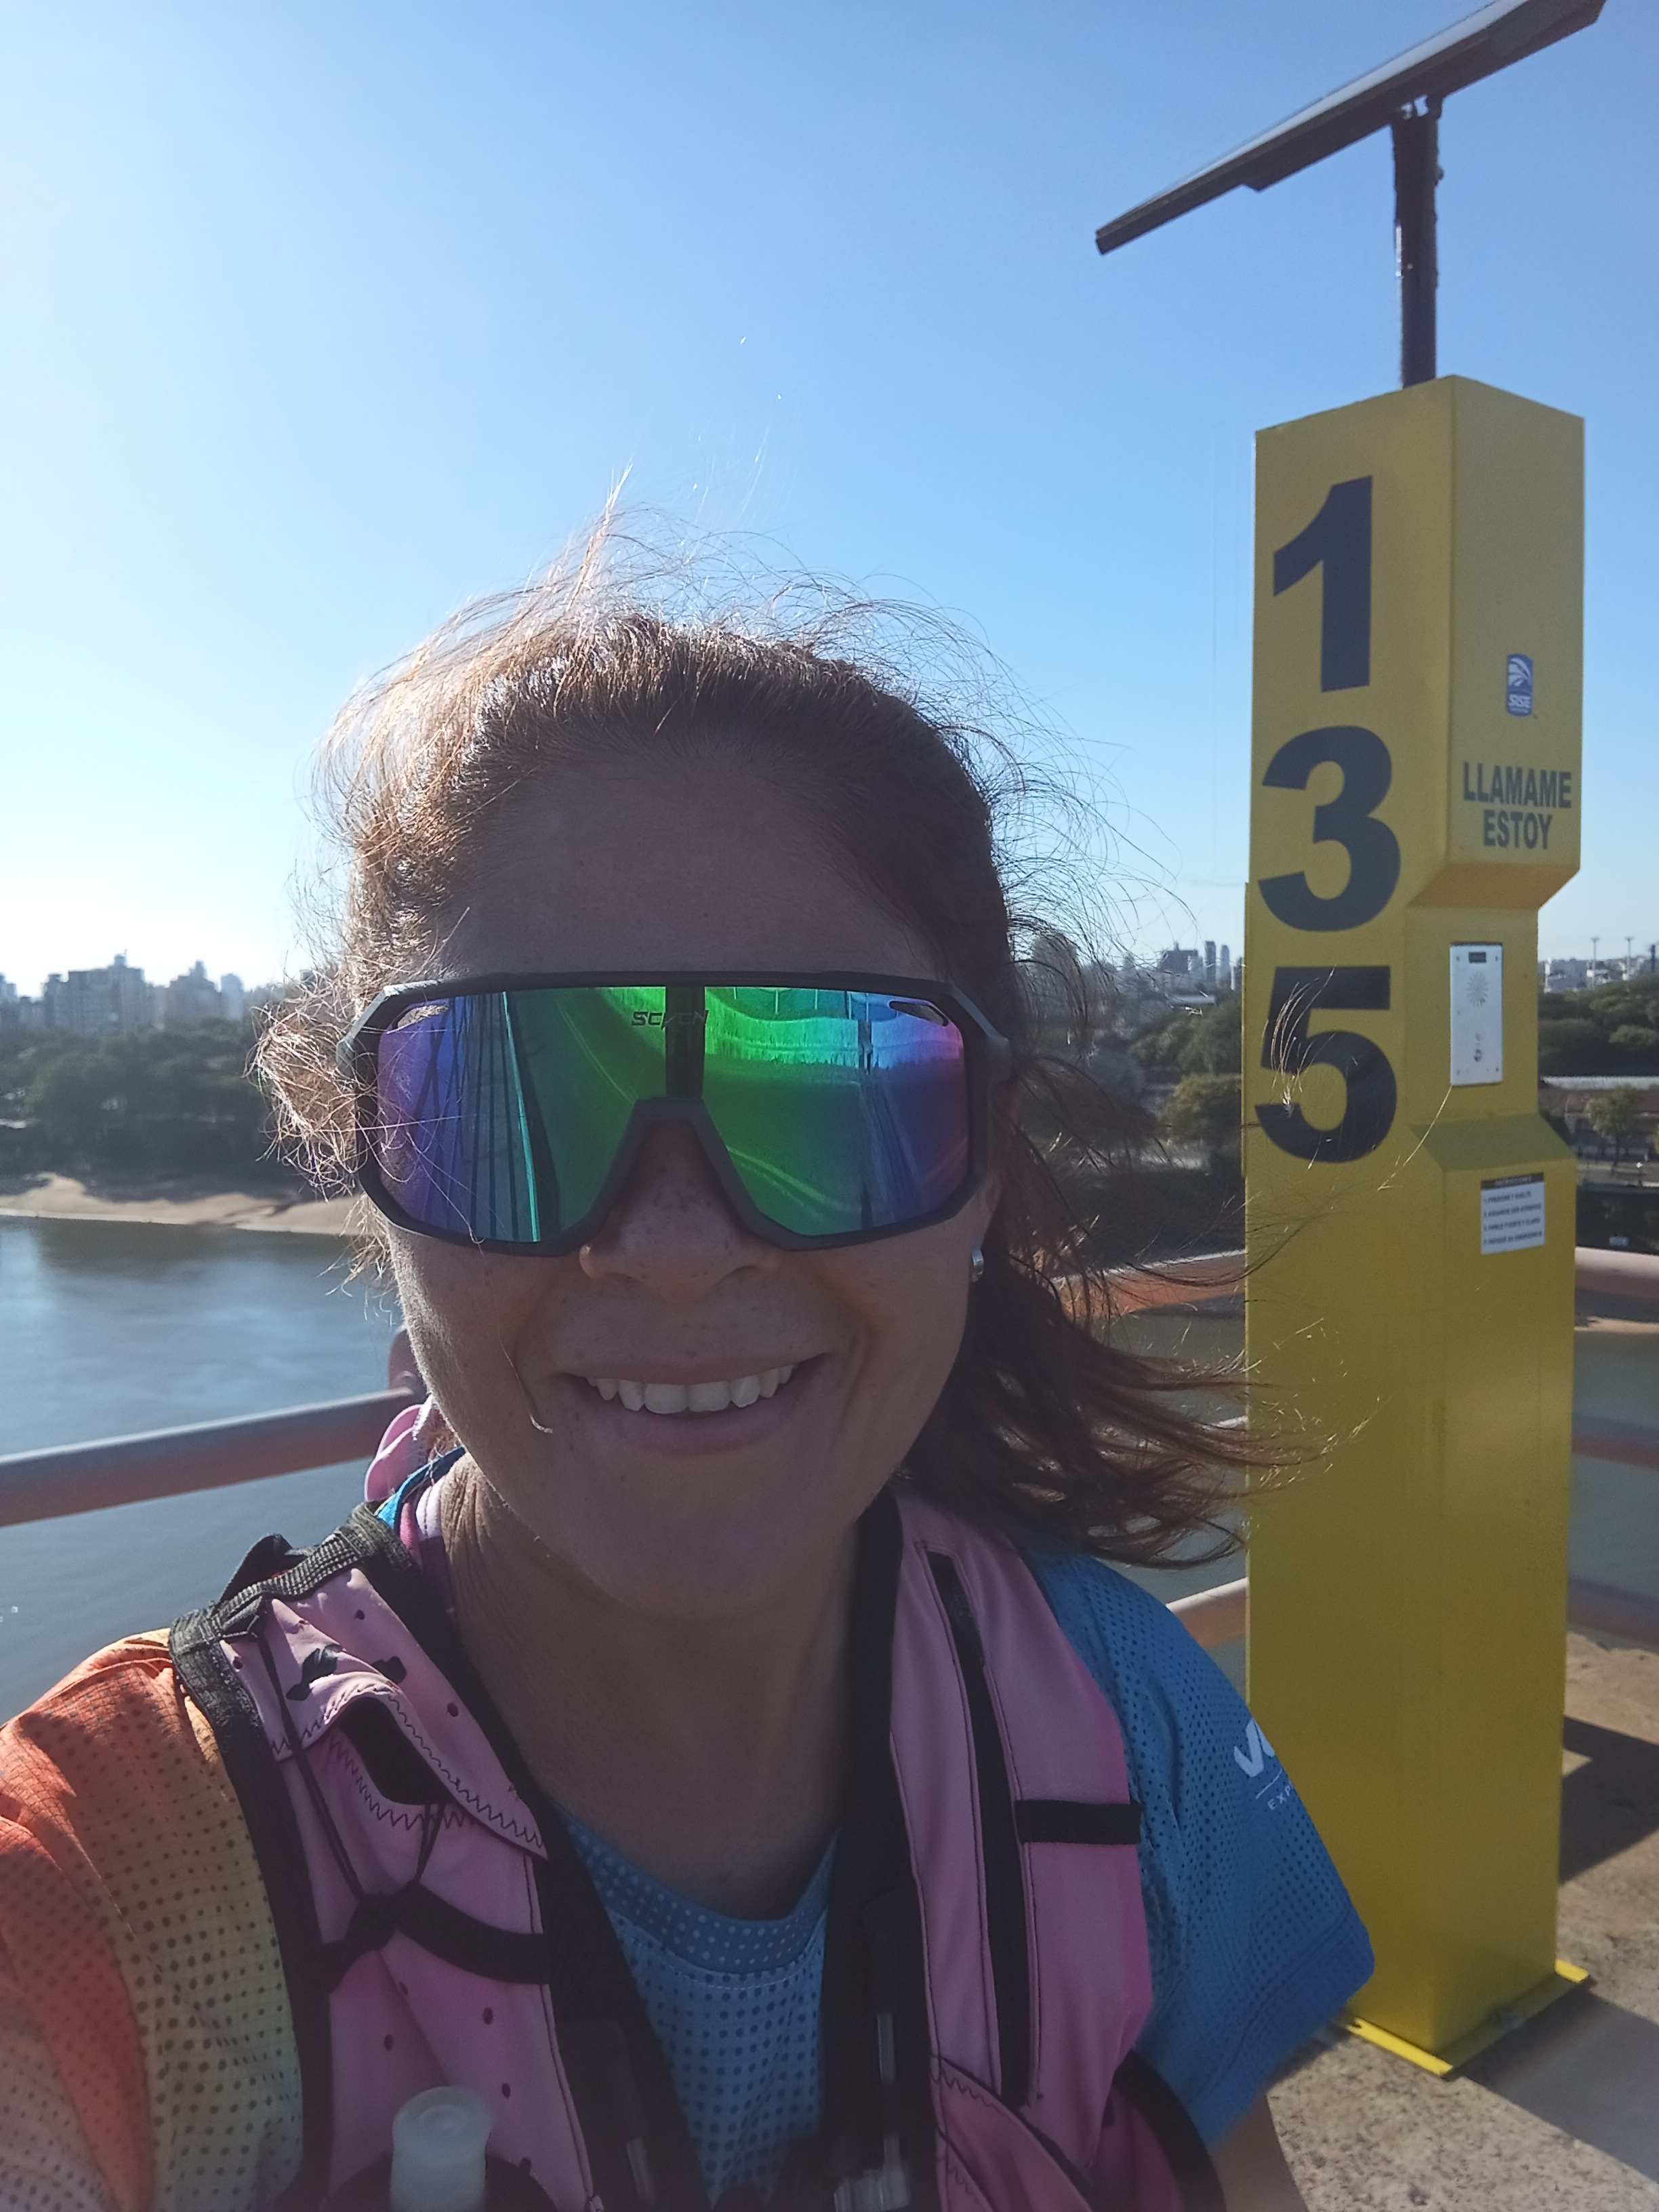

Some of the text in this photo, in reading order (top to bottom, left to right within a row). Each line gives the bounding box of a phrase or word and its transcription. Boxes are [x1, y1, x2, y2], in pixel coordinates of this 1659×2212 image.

[1464, 761, 1572, 808] LLAMAME
[1254, 475, 1401, 1164] 135
[1483, 809, 1553, 849] ESTOY
